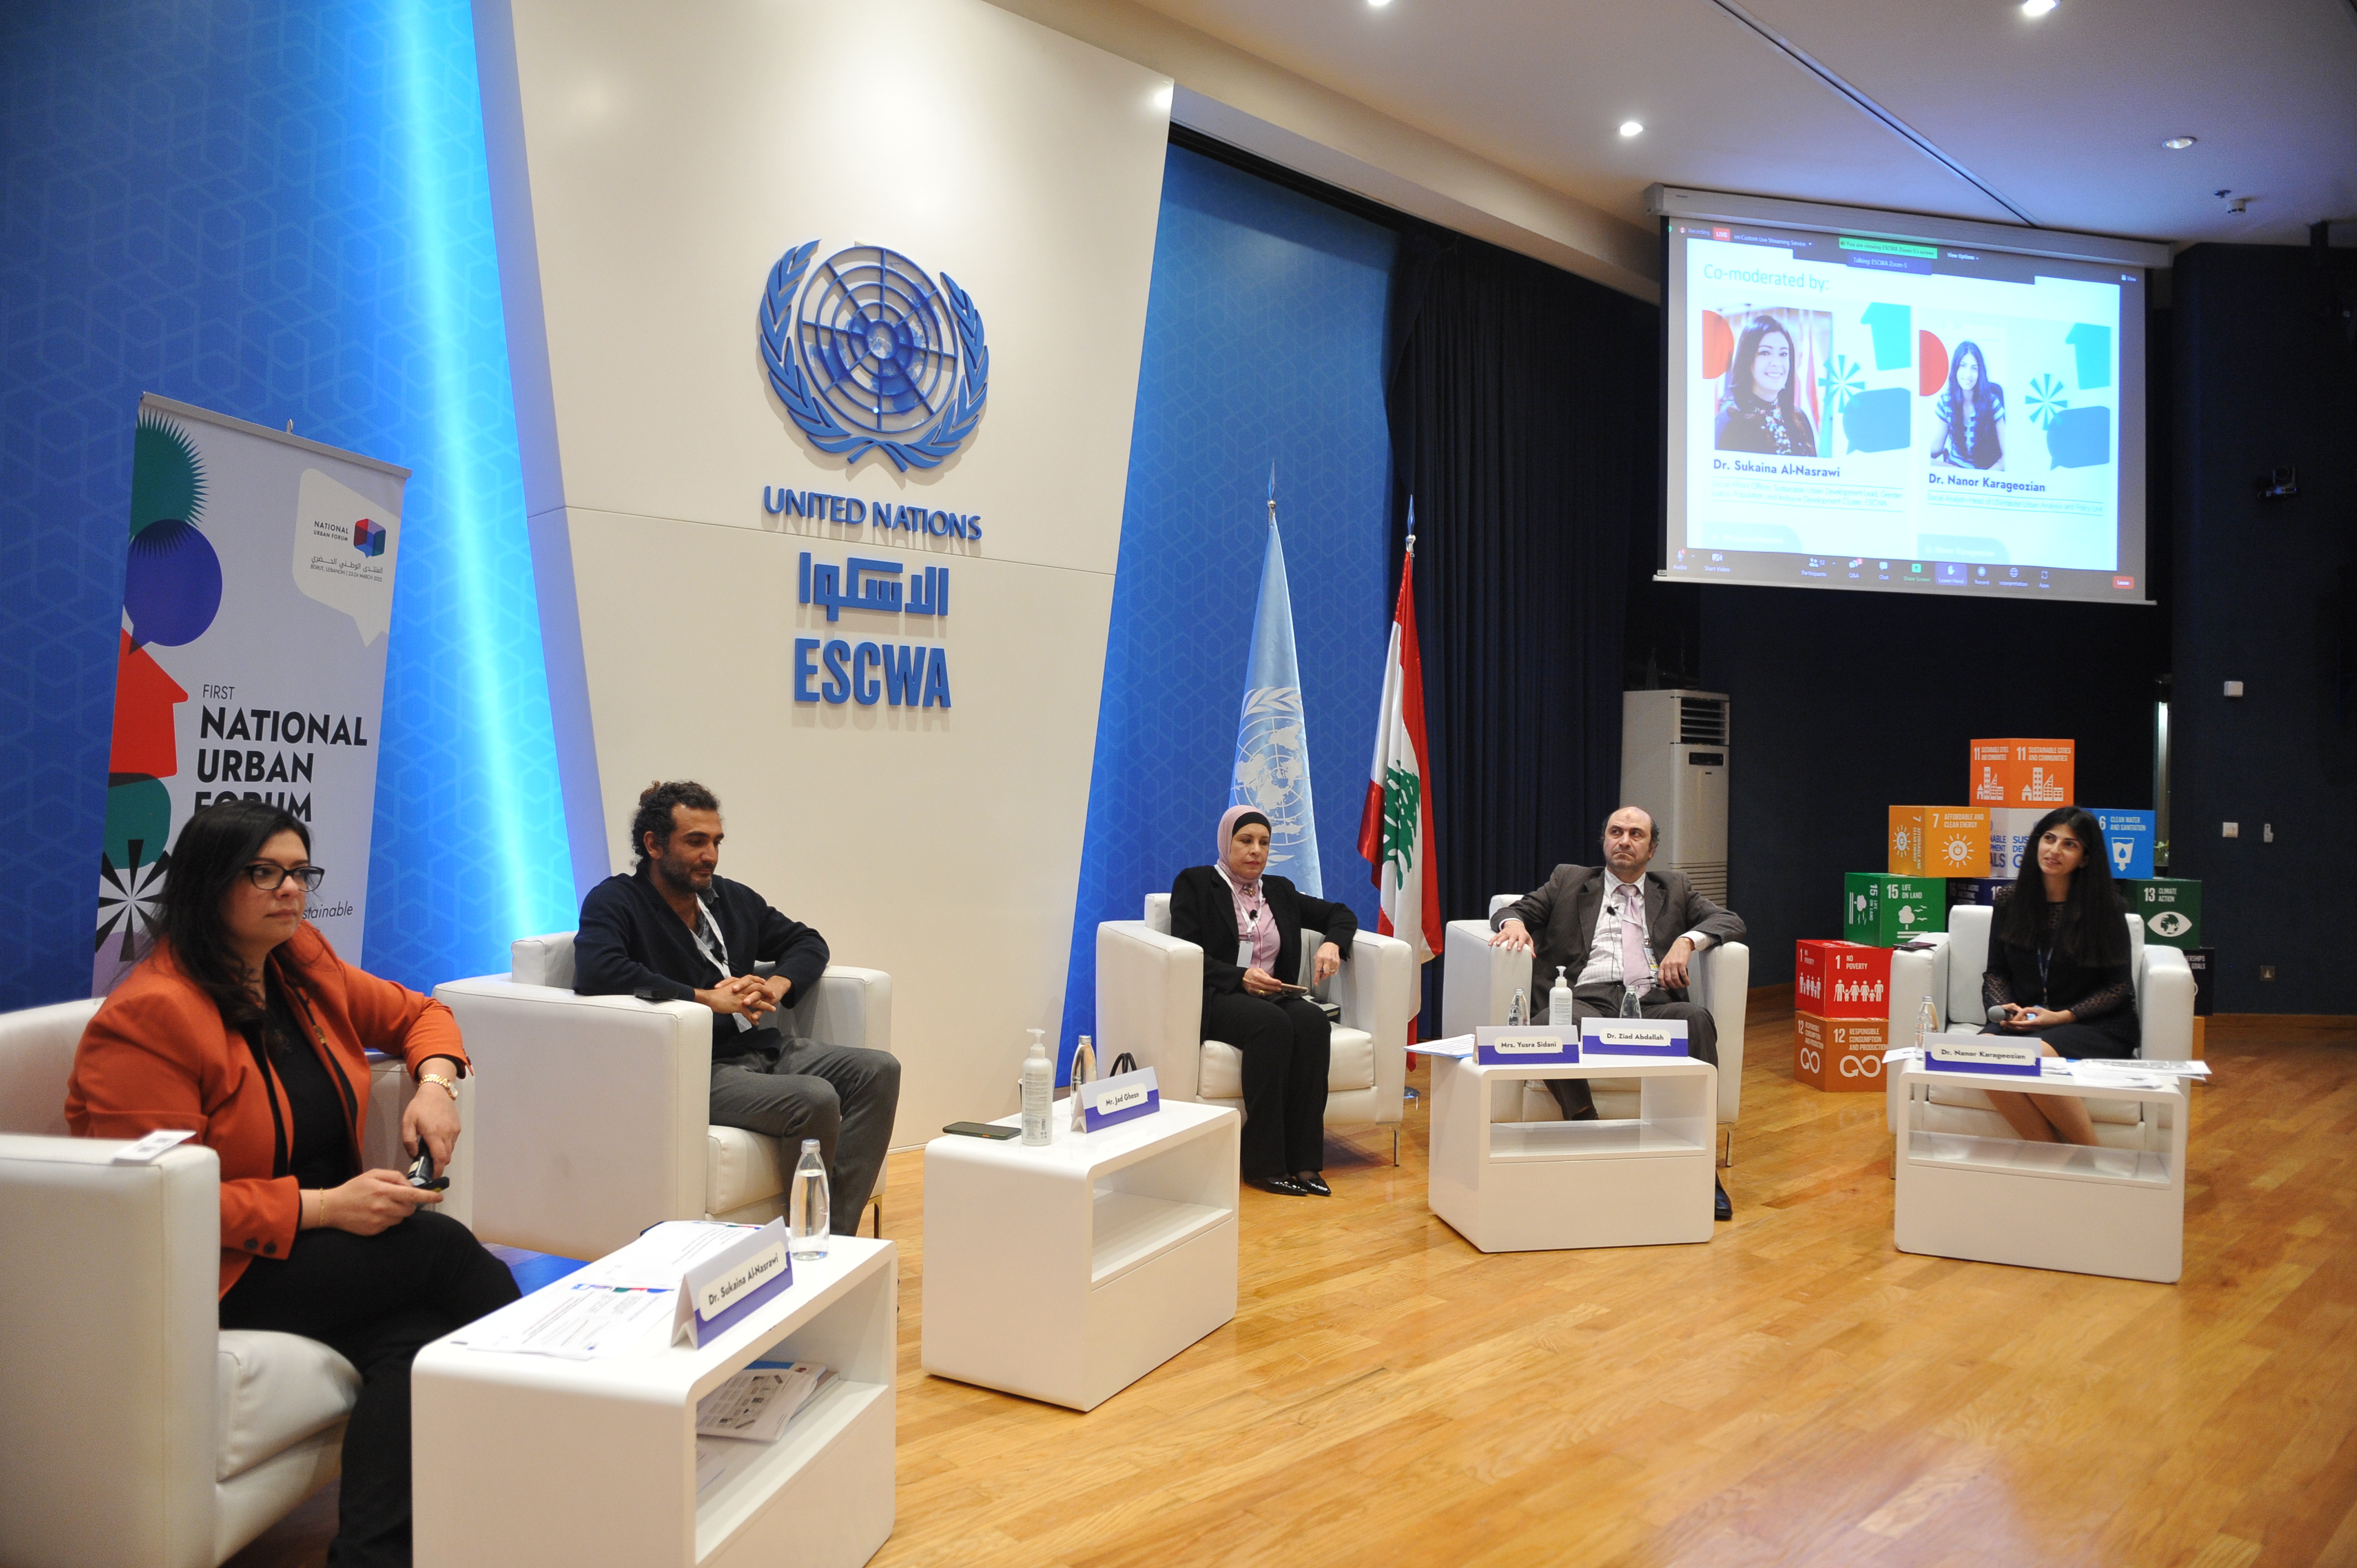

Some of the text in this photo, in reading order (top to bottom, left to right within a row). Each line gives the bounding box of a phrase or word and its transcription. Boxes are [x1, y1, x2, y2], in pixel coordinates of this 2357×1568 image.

[1768, 238, 1790, 247] Streaming
[1889, 260, 1907, 269] Zoom-5
[1704, 264, 1830, 293] Co-moderated by:
[1713, 459, 1840, 478] Dr. Sukaina Al-Nasrawi
[1929, 473, 2046, 493] Dr. Nanor Karageozian
[764, 486, 982, 540] UNITED NATIONS
[315, 520, 349, 534] NATIONAL
[339, 560, 361, 570] الوطني
[795, 638, 951, 708] ESCWA
[203, 684, 235, 700] FIRST
[200, 704, 368, 746] NATIONAL
[1974, 746, 1980, 761] 11
[2016, 746, 2026, 761] 11
[197, 749, 314, 784] URBAN
[1933, 813, 1939, 828] 7
[2099, 816, 2106, 830] 6
[1870, 884, 1878, 896] 15
[1887, 884, 1898, 899] 15
[2144, 888, 2155, 902] 13
[302, 900, 353, 920] stainable
[1800, 948, 1803, 962] 1
[1835, 955, 1840, 969] 1
[1798, 1020, 1804, 1034] 12
[1834, 1028, 1846, 1043] 12
[1979, 1051, 2026, 1060] Karageozian
[1115, 1094, 1123, 1106] Jad
[1124, 1092, 1140, 1101] Ghosn
[708, 1252, 779, 1306] Dr. Sukaina Al-Nasrawi
